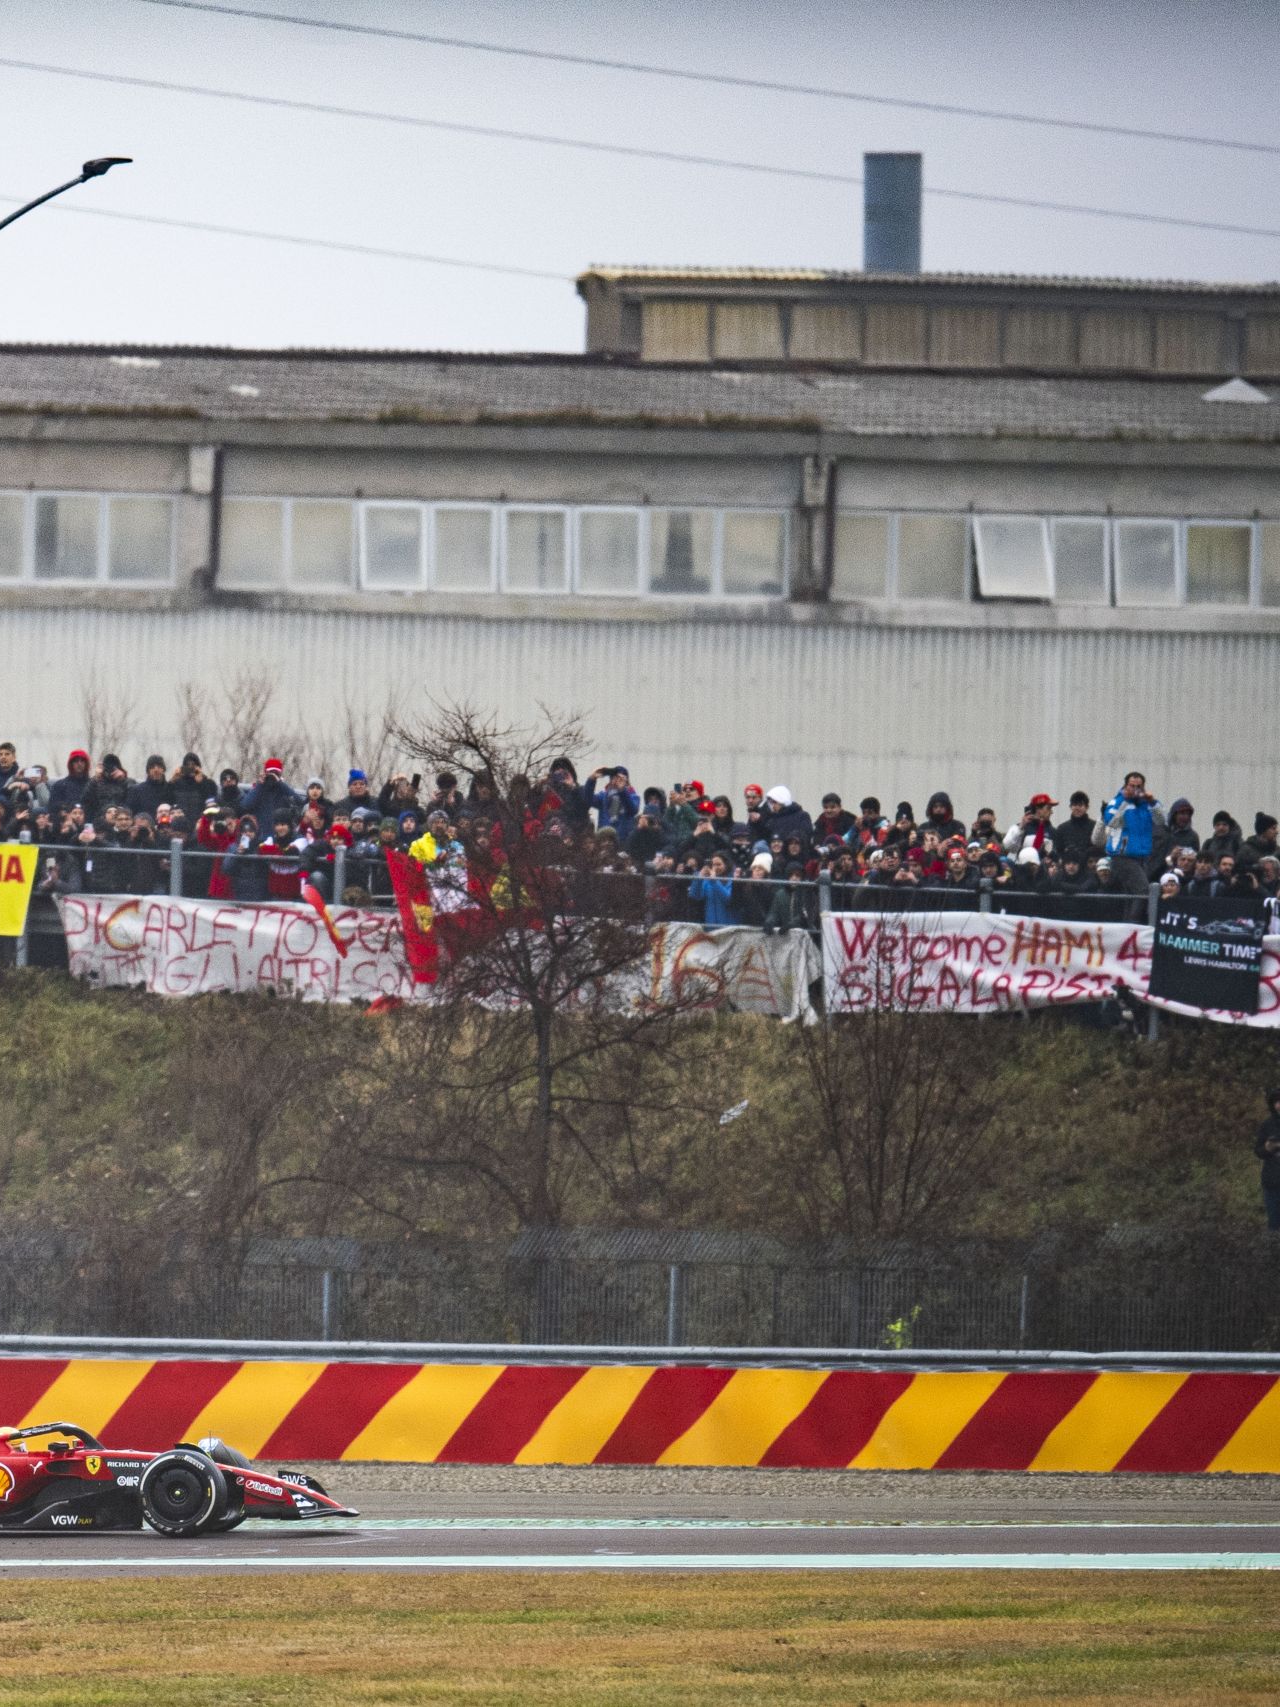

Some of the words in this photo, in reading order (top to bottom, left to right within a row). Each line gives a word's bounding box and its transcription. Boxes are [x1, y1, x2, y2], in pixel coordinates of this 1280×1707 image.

[103, 899, 318, 958] CARLETTO
[835, 917, 1007, 965] Welcome
[1159, 932, 1221, 955] HAMMER
[1184, 956, 1207, 966] LEWIS
[1208, 960, 1248, 971] HAMILTON
[281, 1474, 307, 1485] aws
[51, 1515, 78, 1525] VGW
